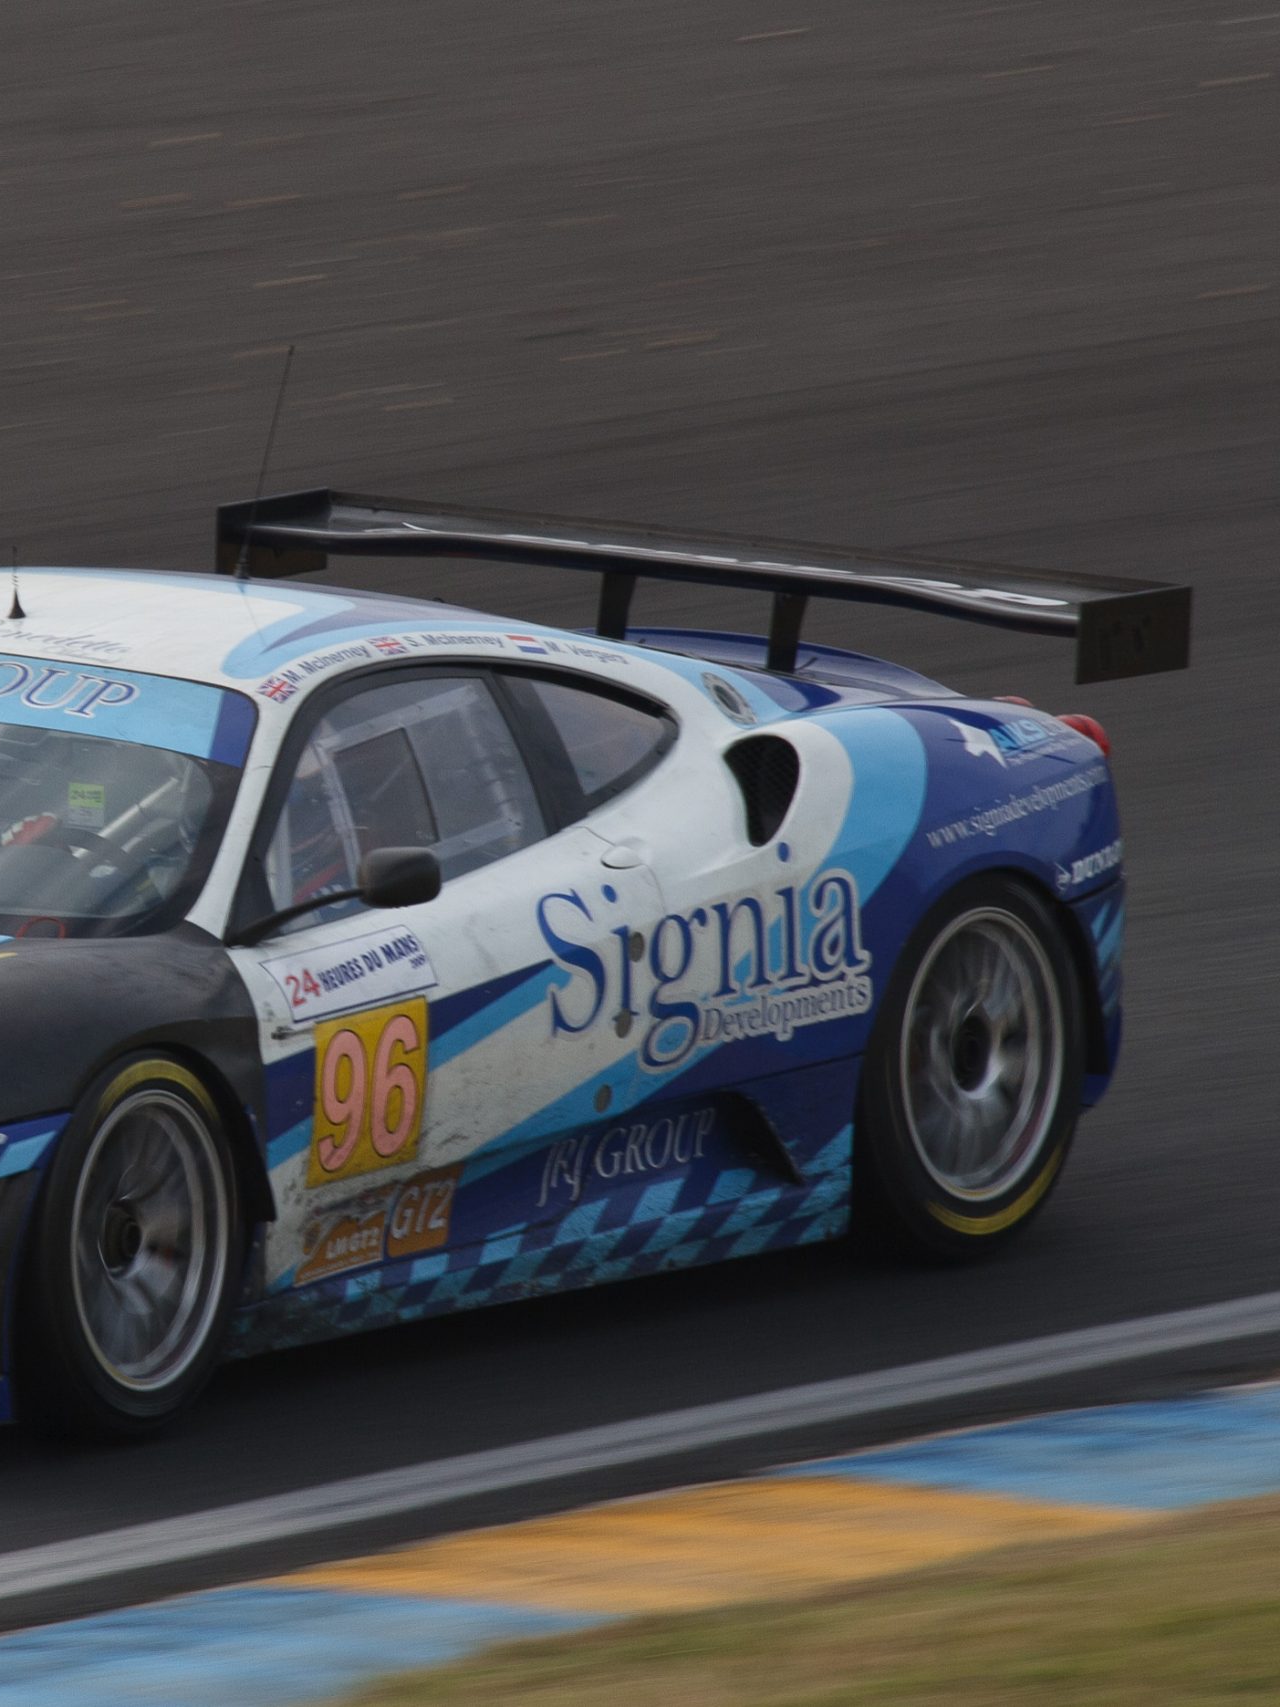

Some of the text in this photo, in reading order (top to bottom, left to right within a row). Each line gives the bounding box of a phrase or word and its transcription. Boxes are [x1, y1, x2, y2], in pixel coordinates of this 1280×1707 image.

[281, 644, 372, 685] M. McInerney
[403, 634, 505, 649] S. McInerney
[285, 934, 419, 1008] 24 HEURES DU MANS
[535, 841, 871, 1070] Signia
[702, 980, 871, 1041] Developments
[318, 1014, 419, 1172] 96
[595, 1107, 716, 1179] GROUP
[391, 1179, 457, 1240] GT2
